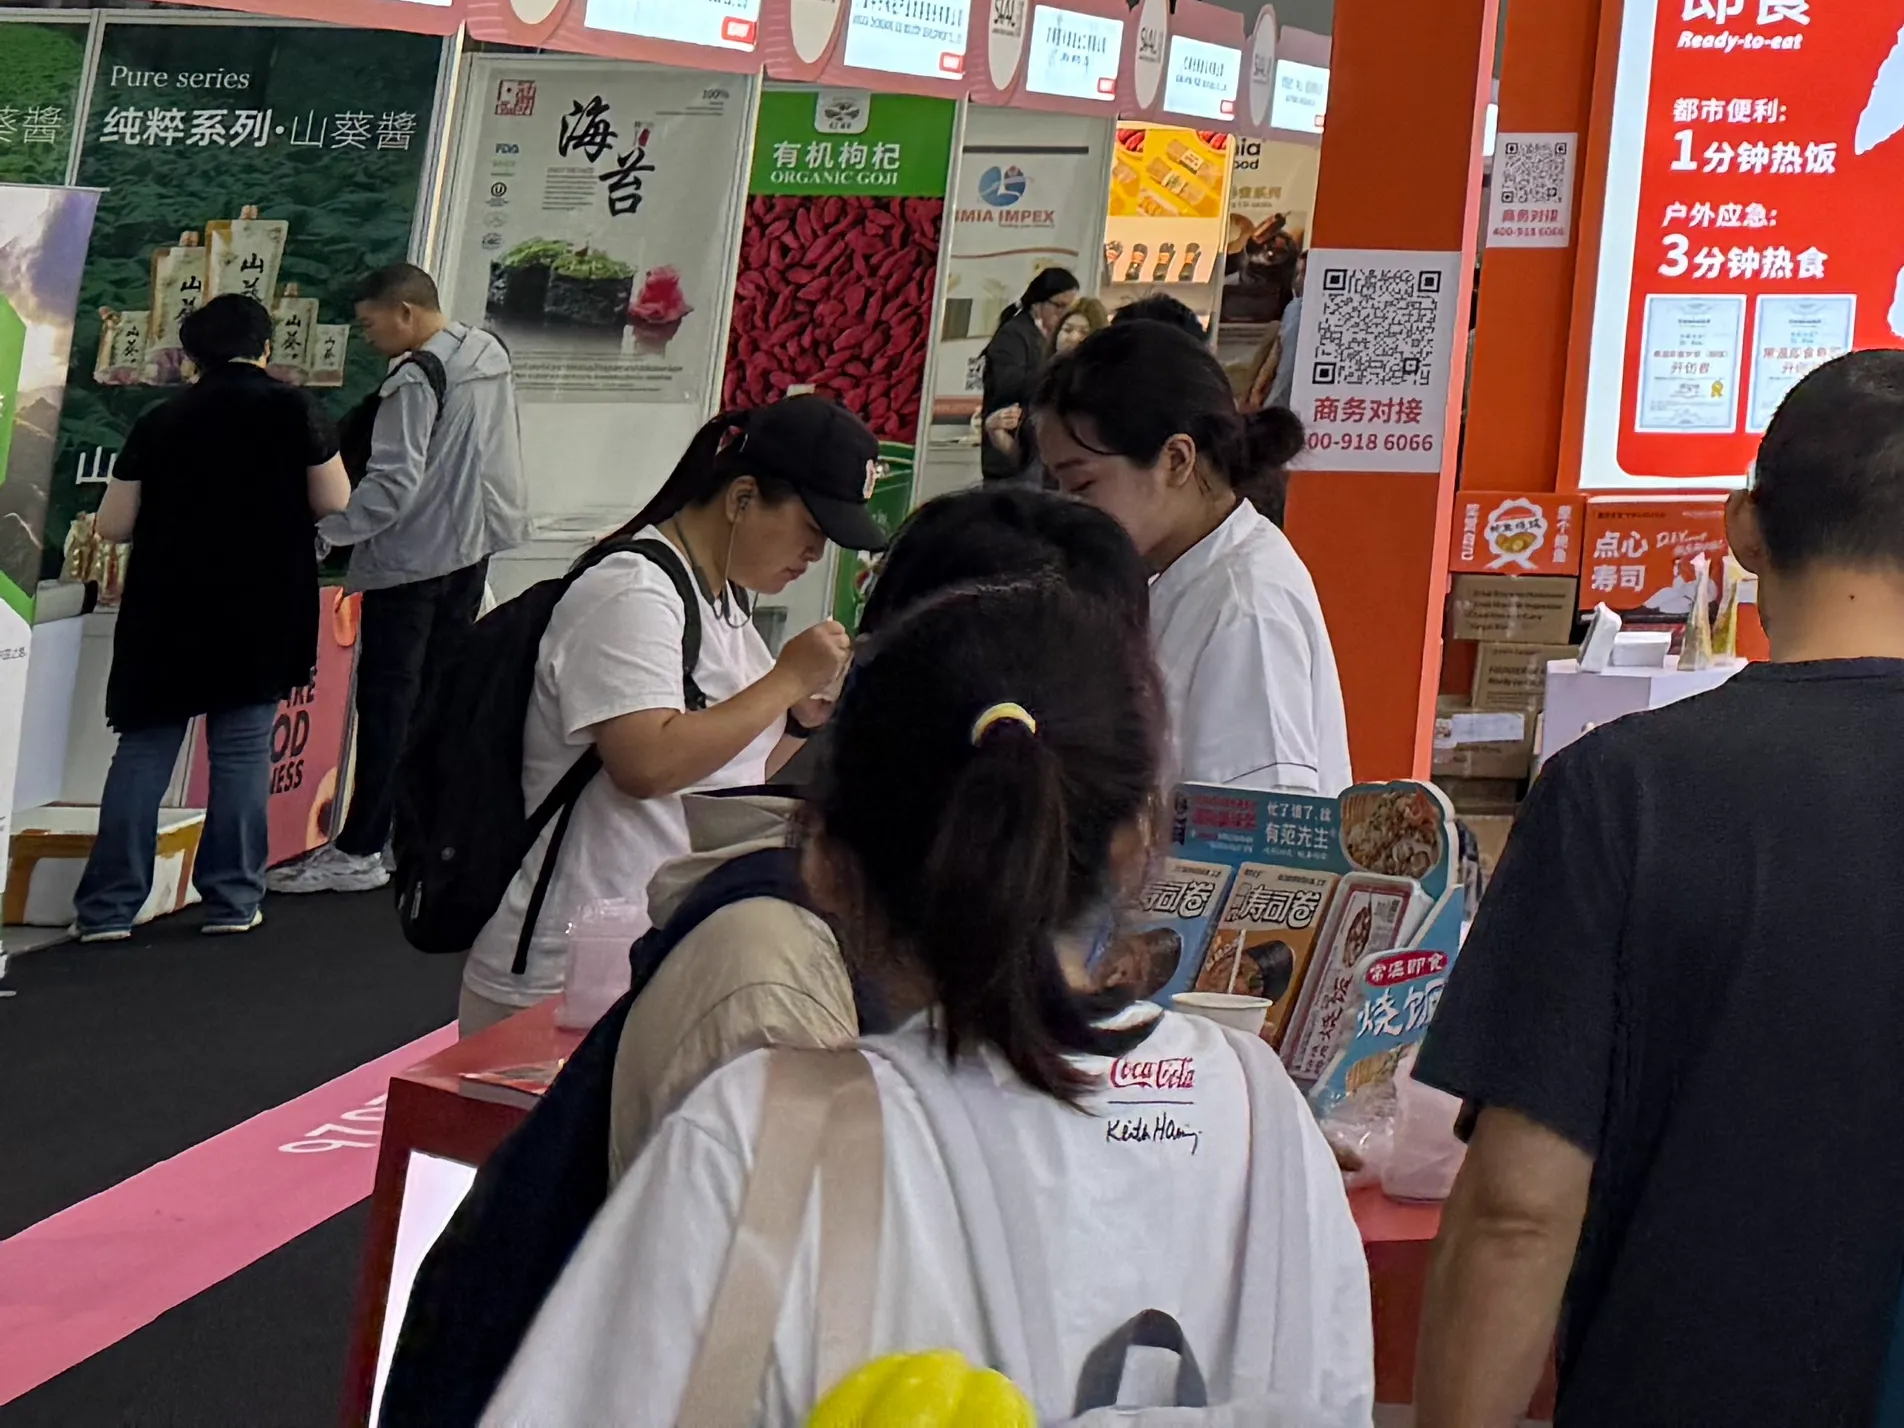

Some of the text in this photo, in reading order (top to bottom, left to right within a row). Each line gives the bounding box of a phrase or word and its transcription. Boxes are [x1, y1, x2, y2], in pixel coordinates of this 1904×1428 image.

[1677, 30, 1804, 52] Ready-to-eat
[110, 65, 250, 90] Pure series
[1672, 98, 1788, 125] 都市便利:
[496, 142, 520, 154] FDA
[558, 95, 656, 216] 海苔
[773, 140, 901, 171] 有机枸杞
[1670, 129, 1837, 175] 1分钟热饭
[771, 171, 898, 185] ORGANIC GOJI
[998, 210, 1056, 223] IMPEX
[1662, 202, 1779, 228] 户外应急:
[1657, 234, 1828, 280] 3分钟热食
[1314, 397, 1424, 424] 商务对接
[1307, 433, 1434, 452] 00-918 6066
[1594, 531, 1649, 559] 点心
[1591, 565, 1647, 593] 寿司
